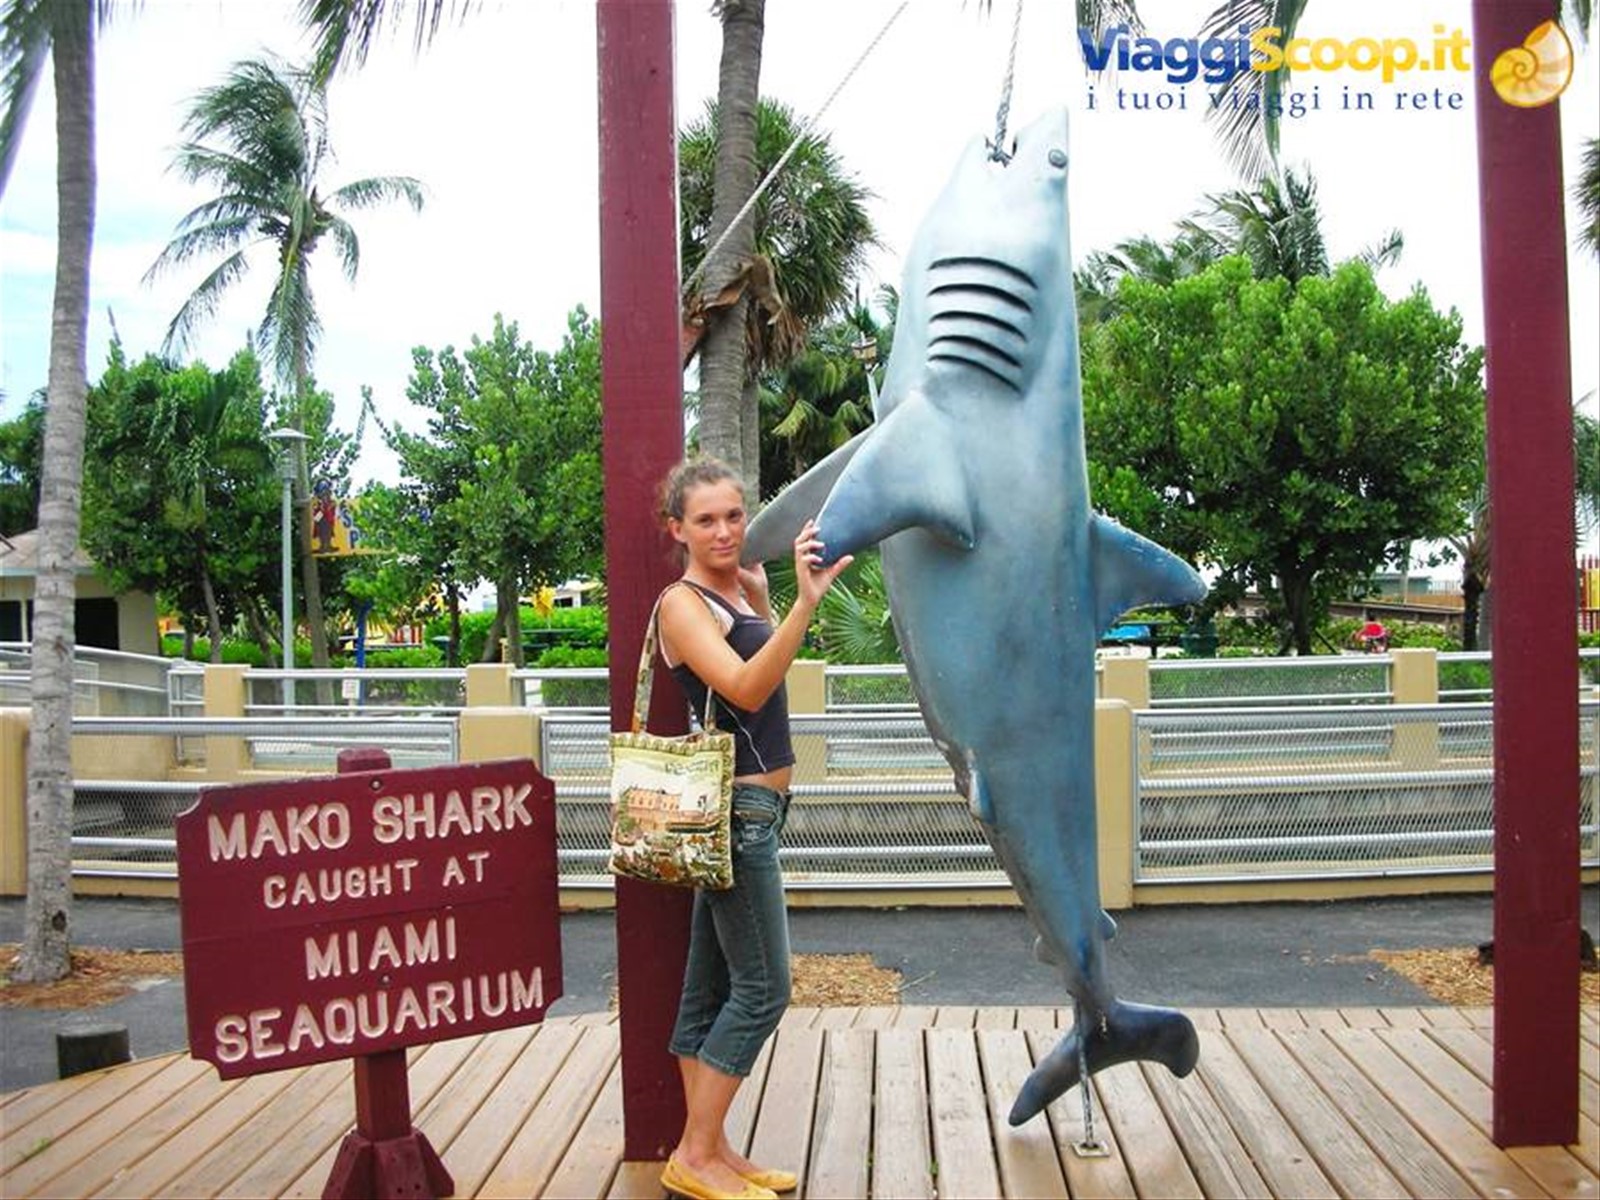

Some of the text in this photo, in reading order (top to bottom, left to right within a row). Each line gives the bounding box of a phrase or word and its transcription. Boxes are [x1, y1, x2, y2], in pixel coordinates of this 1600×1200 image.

[208, 783, 533, 862] MAKO SHARK
[263, 851, 490, 910] CAUGHT AT
[304, 916, 457, 980] MIAMI
[215, 966, 544, 1064] SEAQUARIUM
